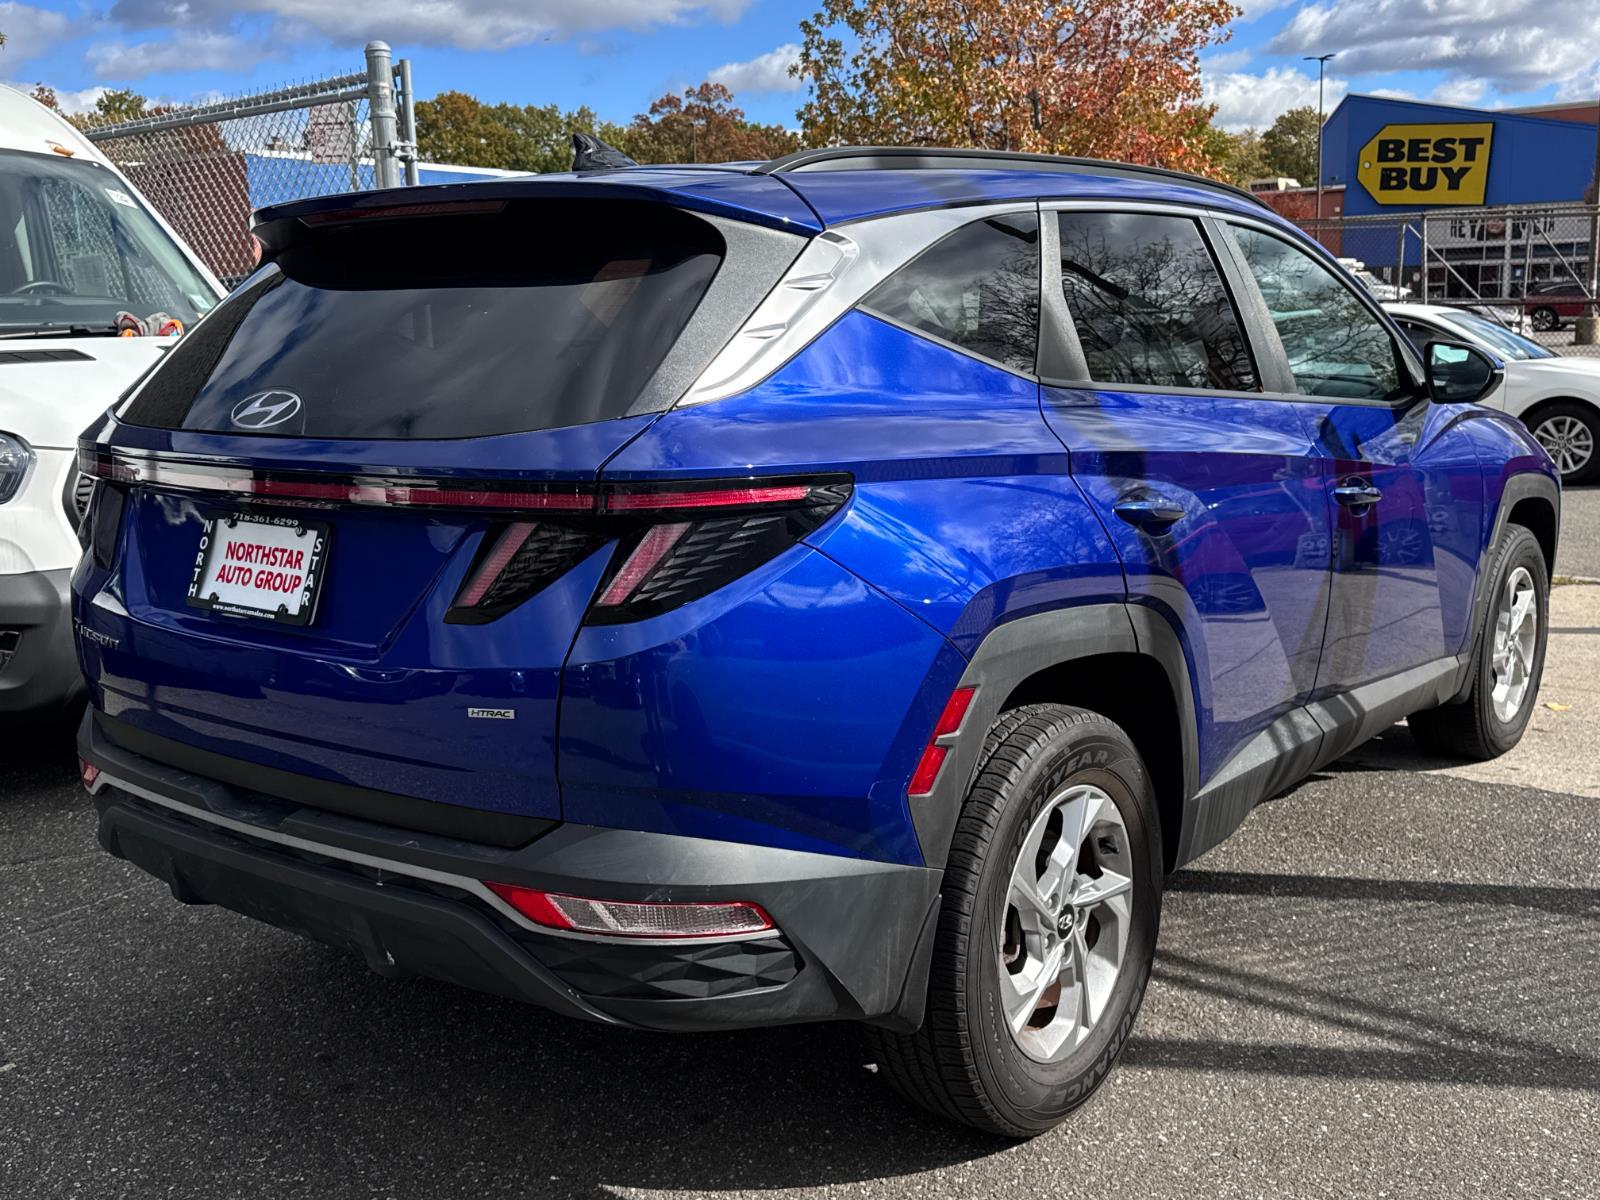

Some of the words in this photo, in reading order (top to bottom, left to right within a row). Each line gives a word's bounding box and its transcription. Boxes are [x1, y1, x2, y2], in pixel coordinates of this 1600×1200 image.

[1376, 137, 1485, 163] BEST
[1378, 166, 1472, 191] BUY
[233, 512, 299, 527] 718-361-6299
[187, 520, 213, 597] NORTH
[225, 541, 304, 570] NORTHSTAR
[216, 564, 253, 587] AUTO
[254, 569, 302, 594] GROUP
[301, 538, 323, 606] STAR
[471, 709, 511, 718] HTRAC
